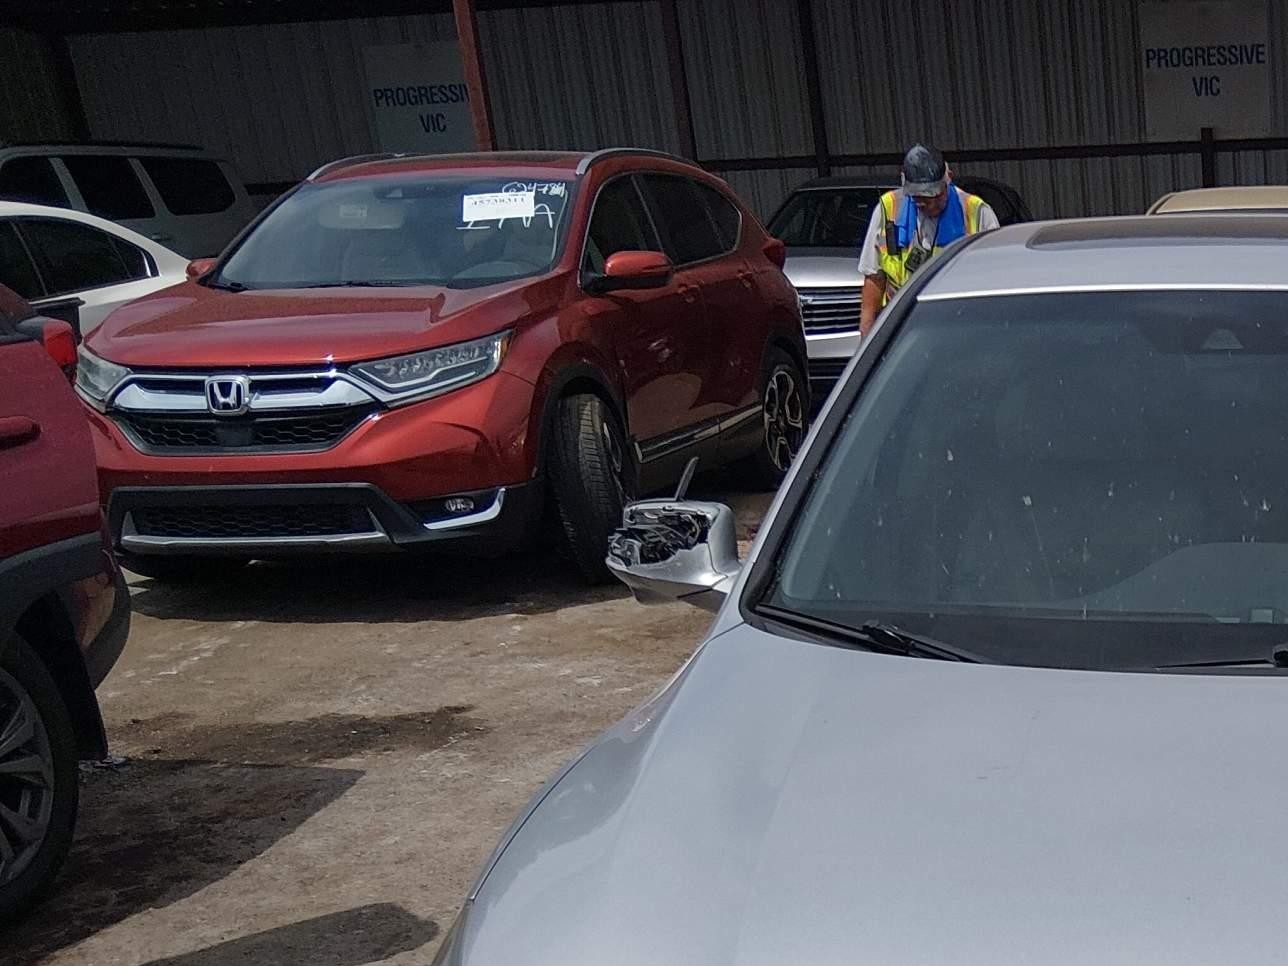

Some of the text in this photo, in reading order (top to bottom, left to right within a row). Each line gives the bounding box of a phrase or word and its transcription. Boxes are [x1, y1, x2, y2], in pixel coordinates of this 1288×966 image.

[1146, 44, 1266, 69] PROGRESSIVE
[373, 83, 470, 107] PROGRESSI
[1192, 76, 1221, 97] VIC
[420, 113, 447, 133] VIC
